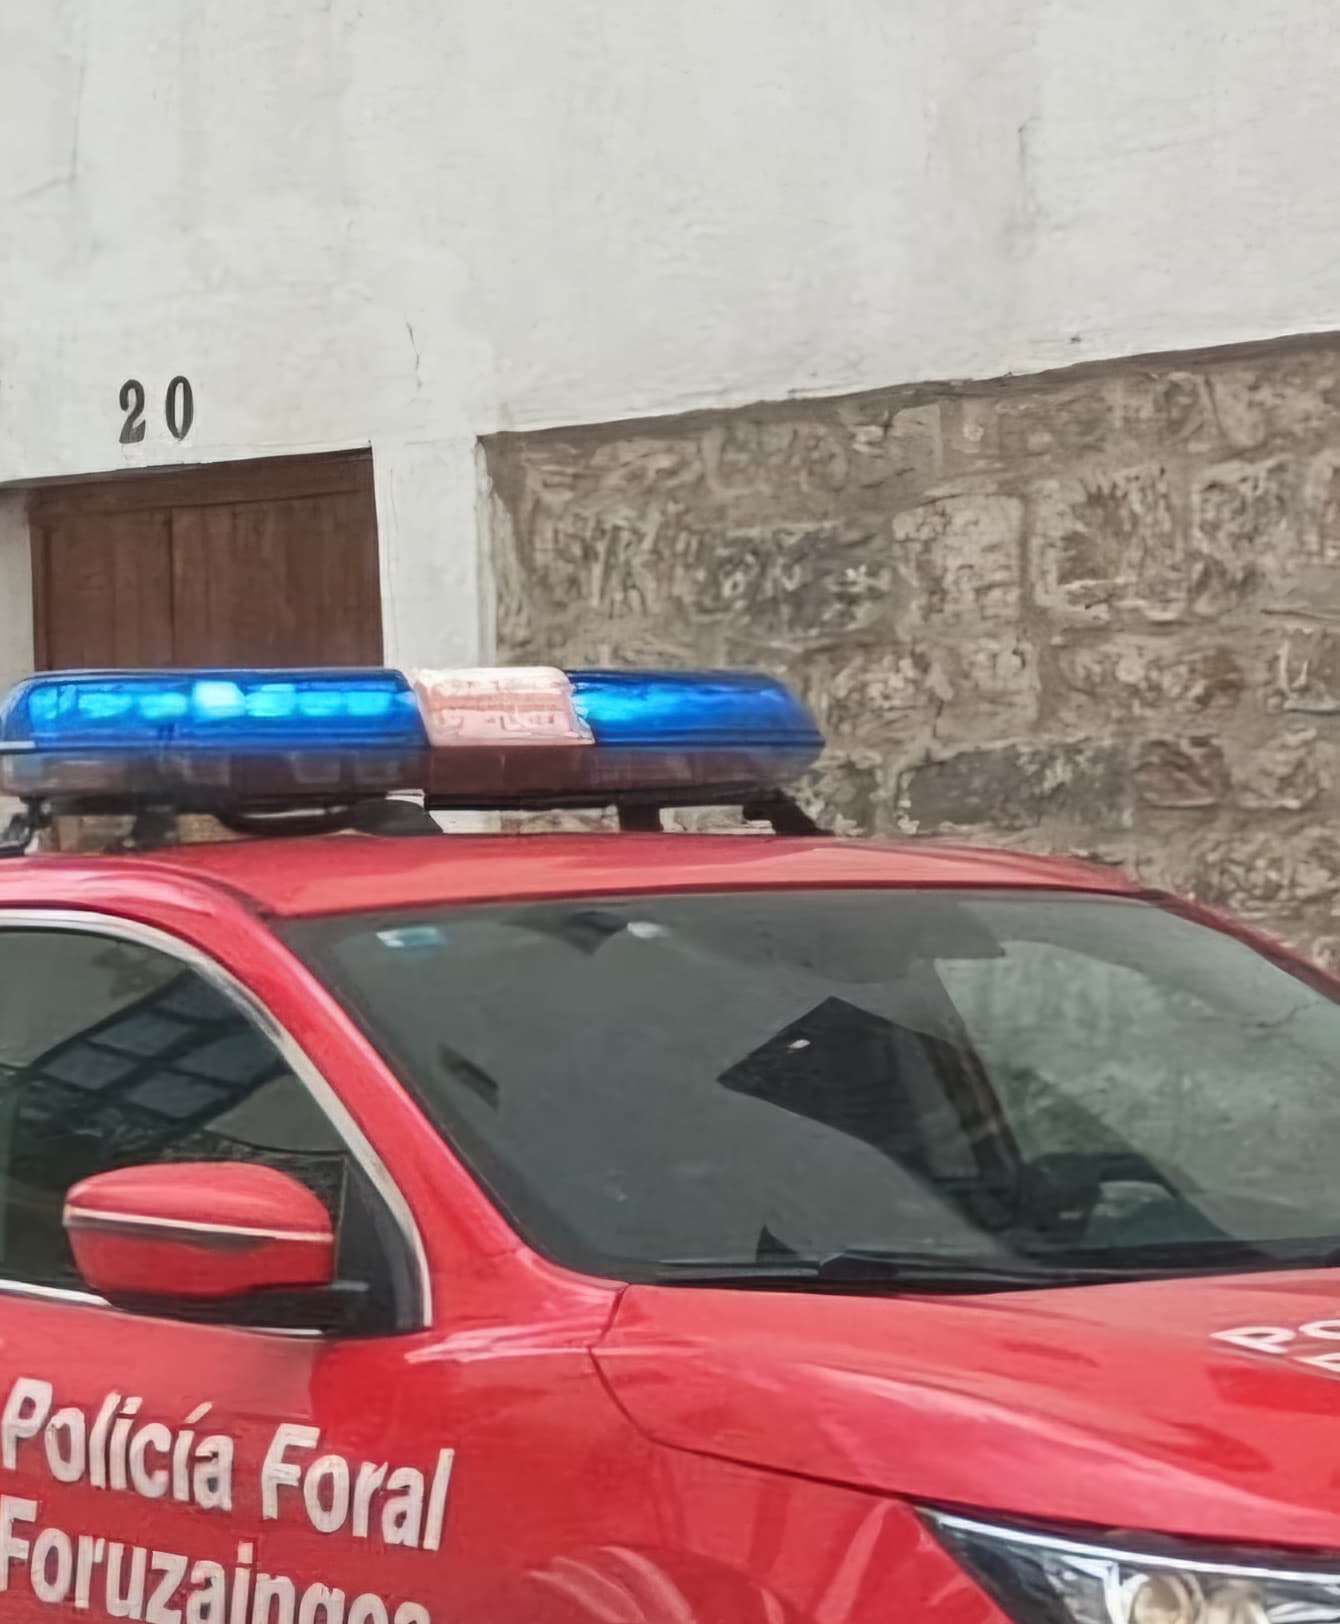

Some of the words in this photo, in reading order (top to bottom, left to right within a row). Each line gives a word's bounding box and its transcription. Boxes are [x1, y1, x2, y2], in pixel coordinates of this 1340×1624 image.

[118, 375, 194, 444] 20
[0, 1377, 234, 1512] Policía
[261, 1422, 455, 1551] Foral
